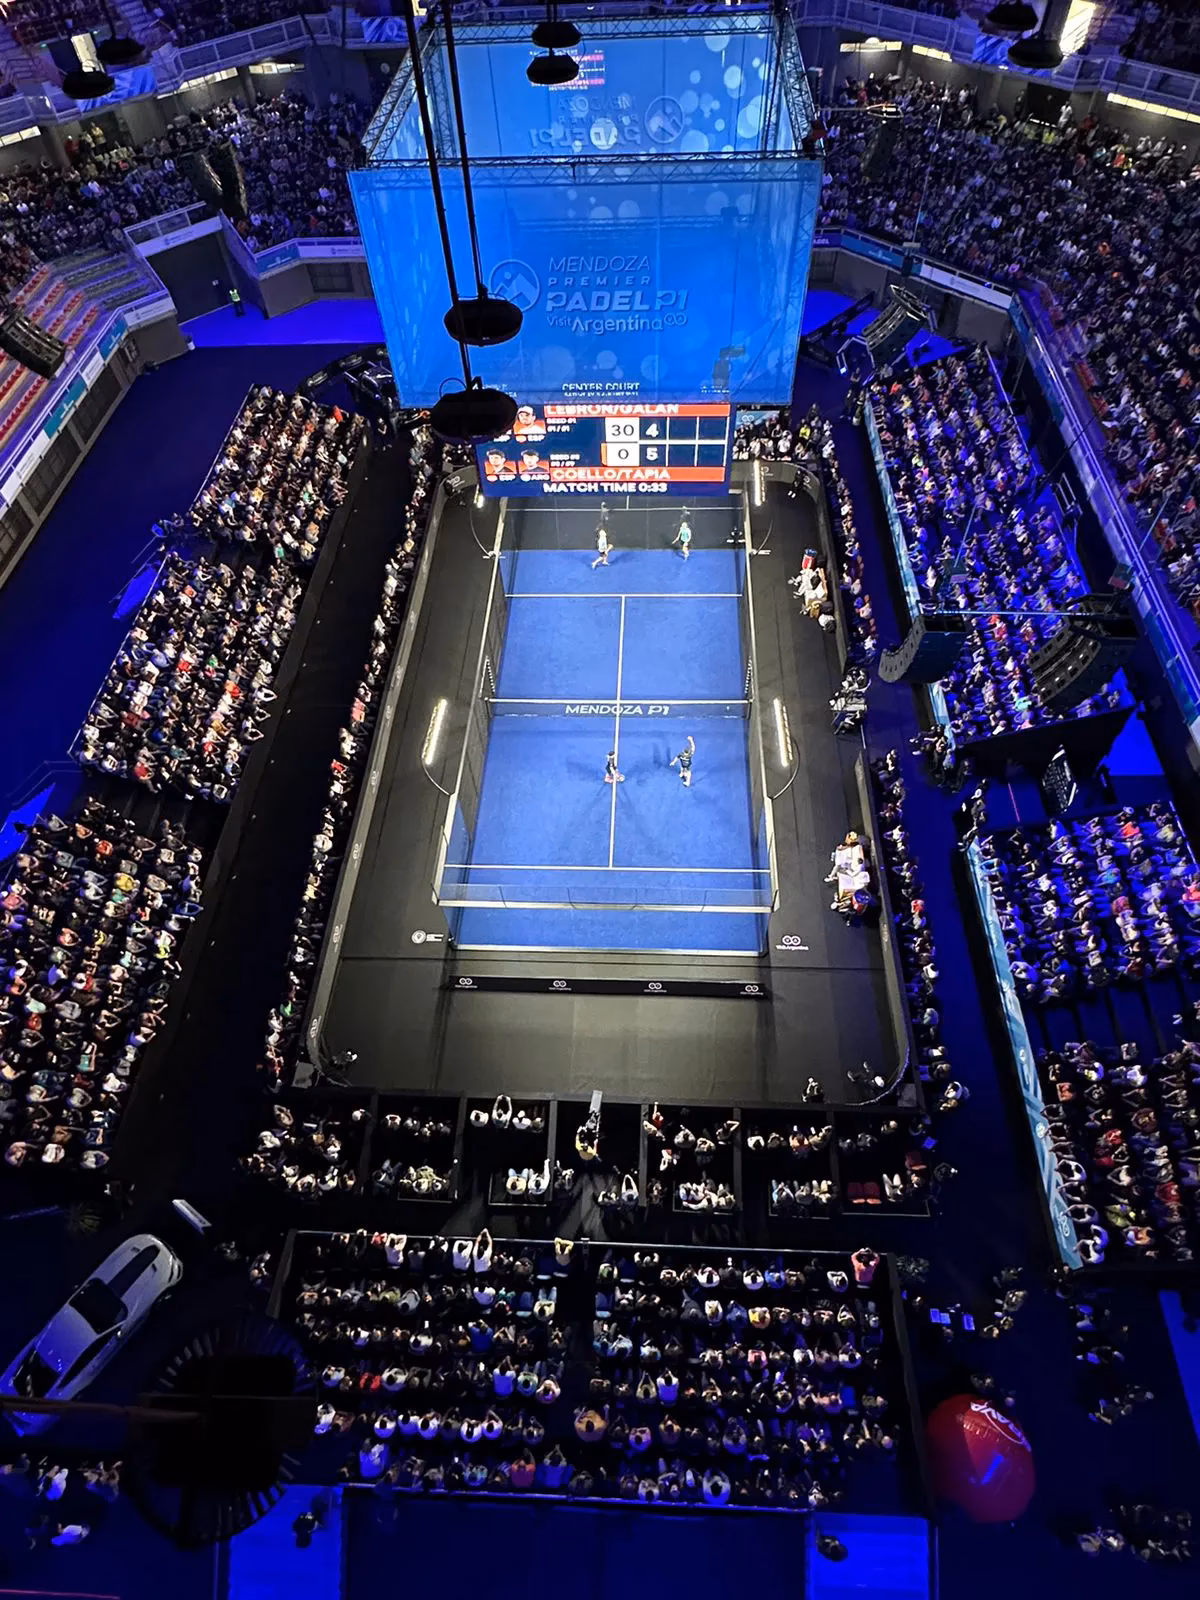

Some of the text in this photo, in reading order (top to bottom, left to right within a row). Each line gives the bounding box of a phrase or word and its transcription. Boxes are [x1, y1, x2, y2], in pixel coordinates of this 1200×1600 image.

[548, 255, 651, 273] MENDOZA
[547, 275, 652, 287] PREMIER
[546, 288, 689, 312] PADEL P1
[571, 315, 664, 335] Argentina
[562, 382, 640, 391] CENTER COURT
[546, 403, 680, 415] LEBRON/GALAN
[611, 423, 659, 438] 30 4
[618, 447, 659, 461] 0 5
[552, 468, 671, 480] COELLO/TAPIA
[543, 482, 599, 493] MATCH
[600, 482, 637, 493] TIME
[565, 704, 670, 716] MENDOZA P1
